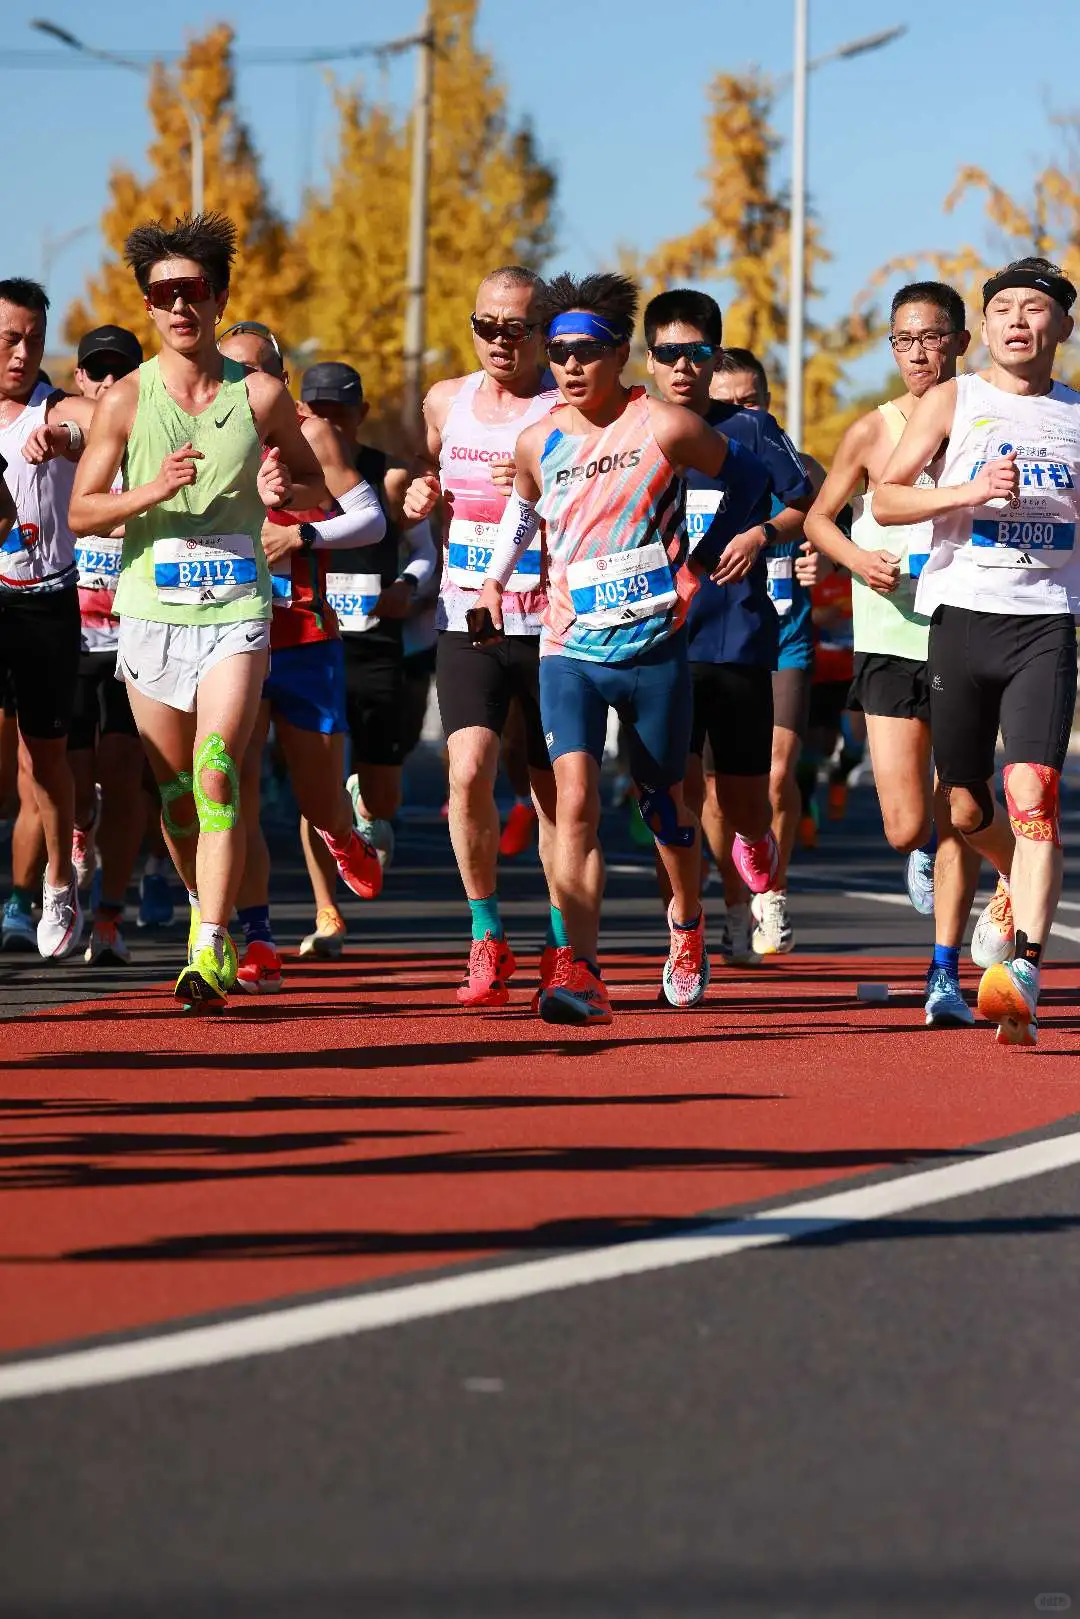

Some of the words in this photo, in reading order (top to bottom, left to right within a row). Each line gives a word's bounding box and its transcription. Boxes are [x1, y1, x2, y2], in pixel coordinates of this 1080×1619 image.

[556, 448, 641, 486] BROOKS
[998, 522, 1053, 544] B2080
[178, 560, 234, 582] B2112
[595, 574, 649, 604] A0549
